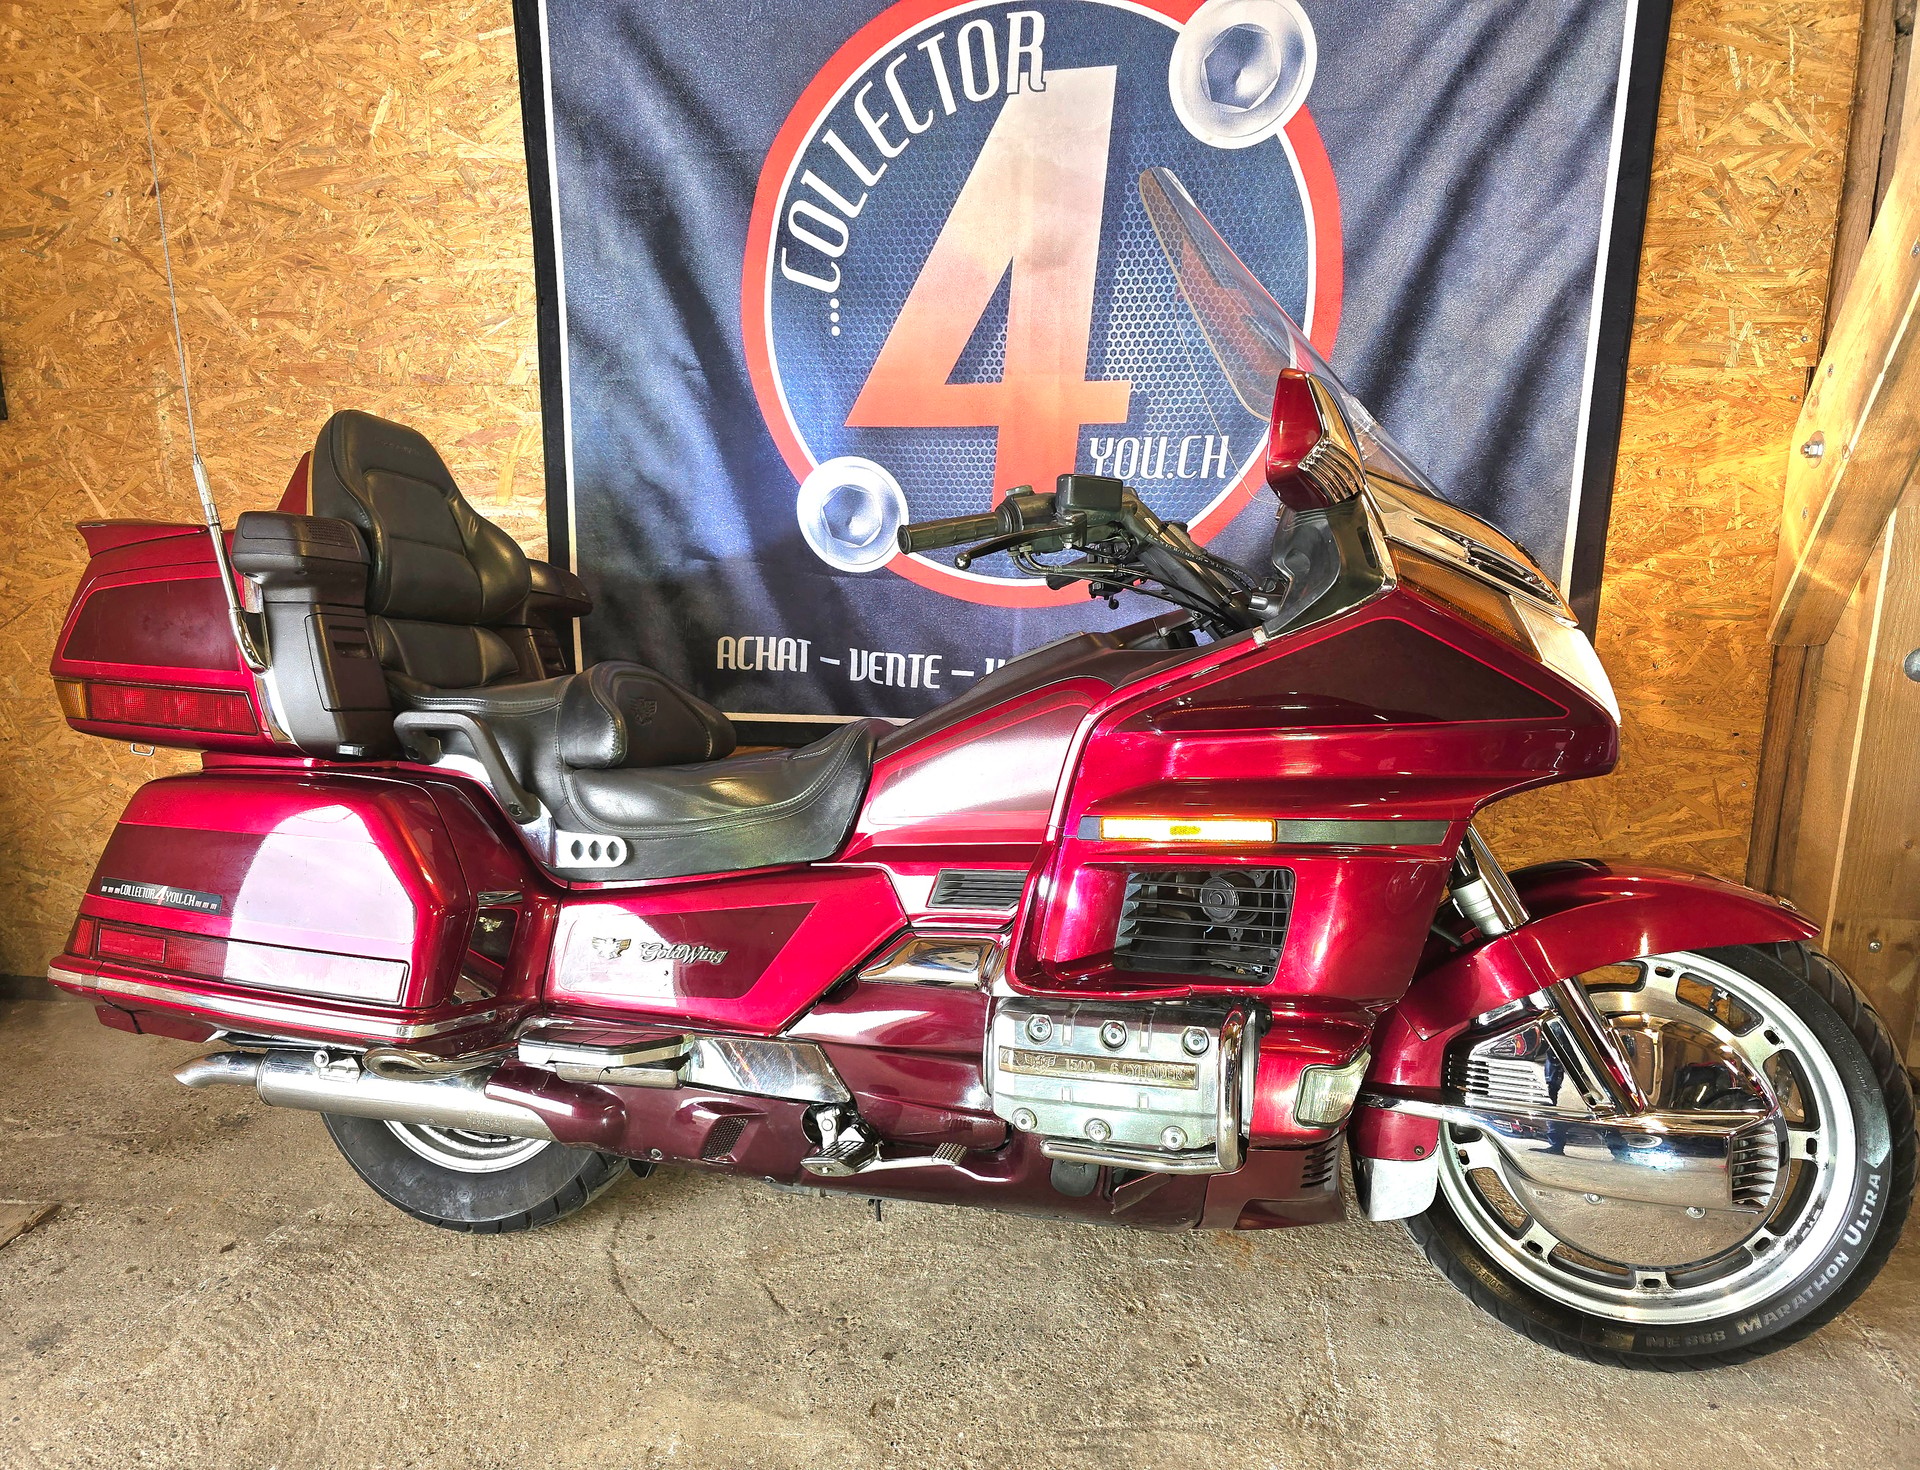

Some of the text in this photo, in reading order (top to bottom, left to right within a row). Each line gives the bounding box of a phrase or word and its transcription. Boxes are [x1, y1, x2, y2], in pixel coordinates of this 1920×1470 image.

[844, 65, 1131, 512] 4
[1089, 434, 1230, 480] YOU.CH
[716, 636, 812, 673] ACHAT
[849, 648, 943, 689] VENTE
[640, 941, 729, 965] GoldWing
[1064, 1058, 1096, 1072] 1500
[1110, 1062, 1119, 1075] 6
[1735, 1250, 1850, 1336] MARATHON
[1842, 1173, 1882, 1247] ULTRA
